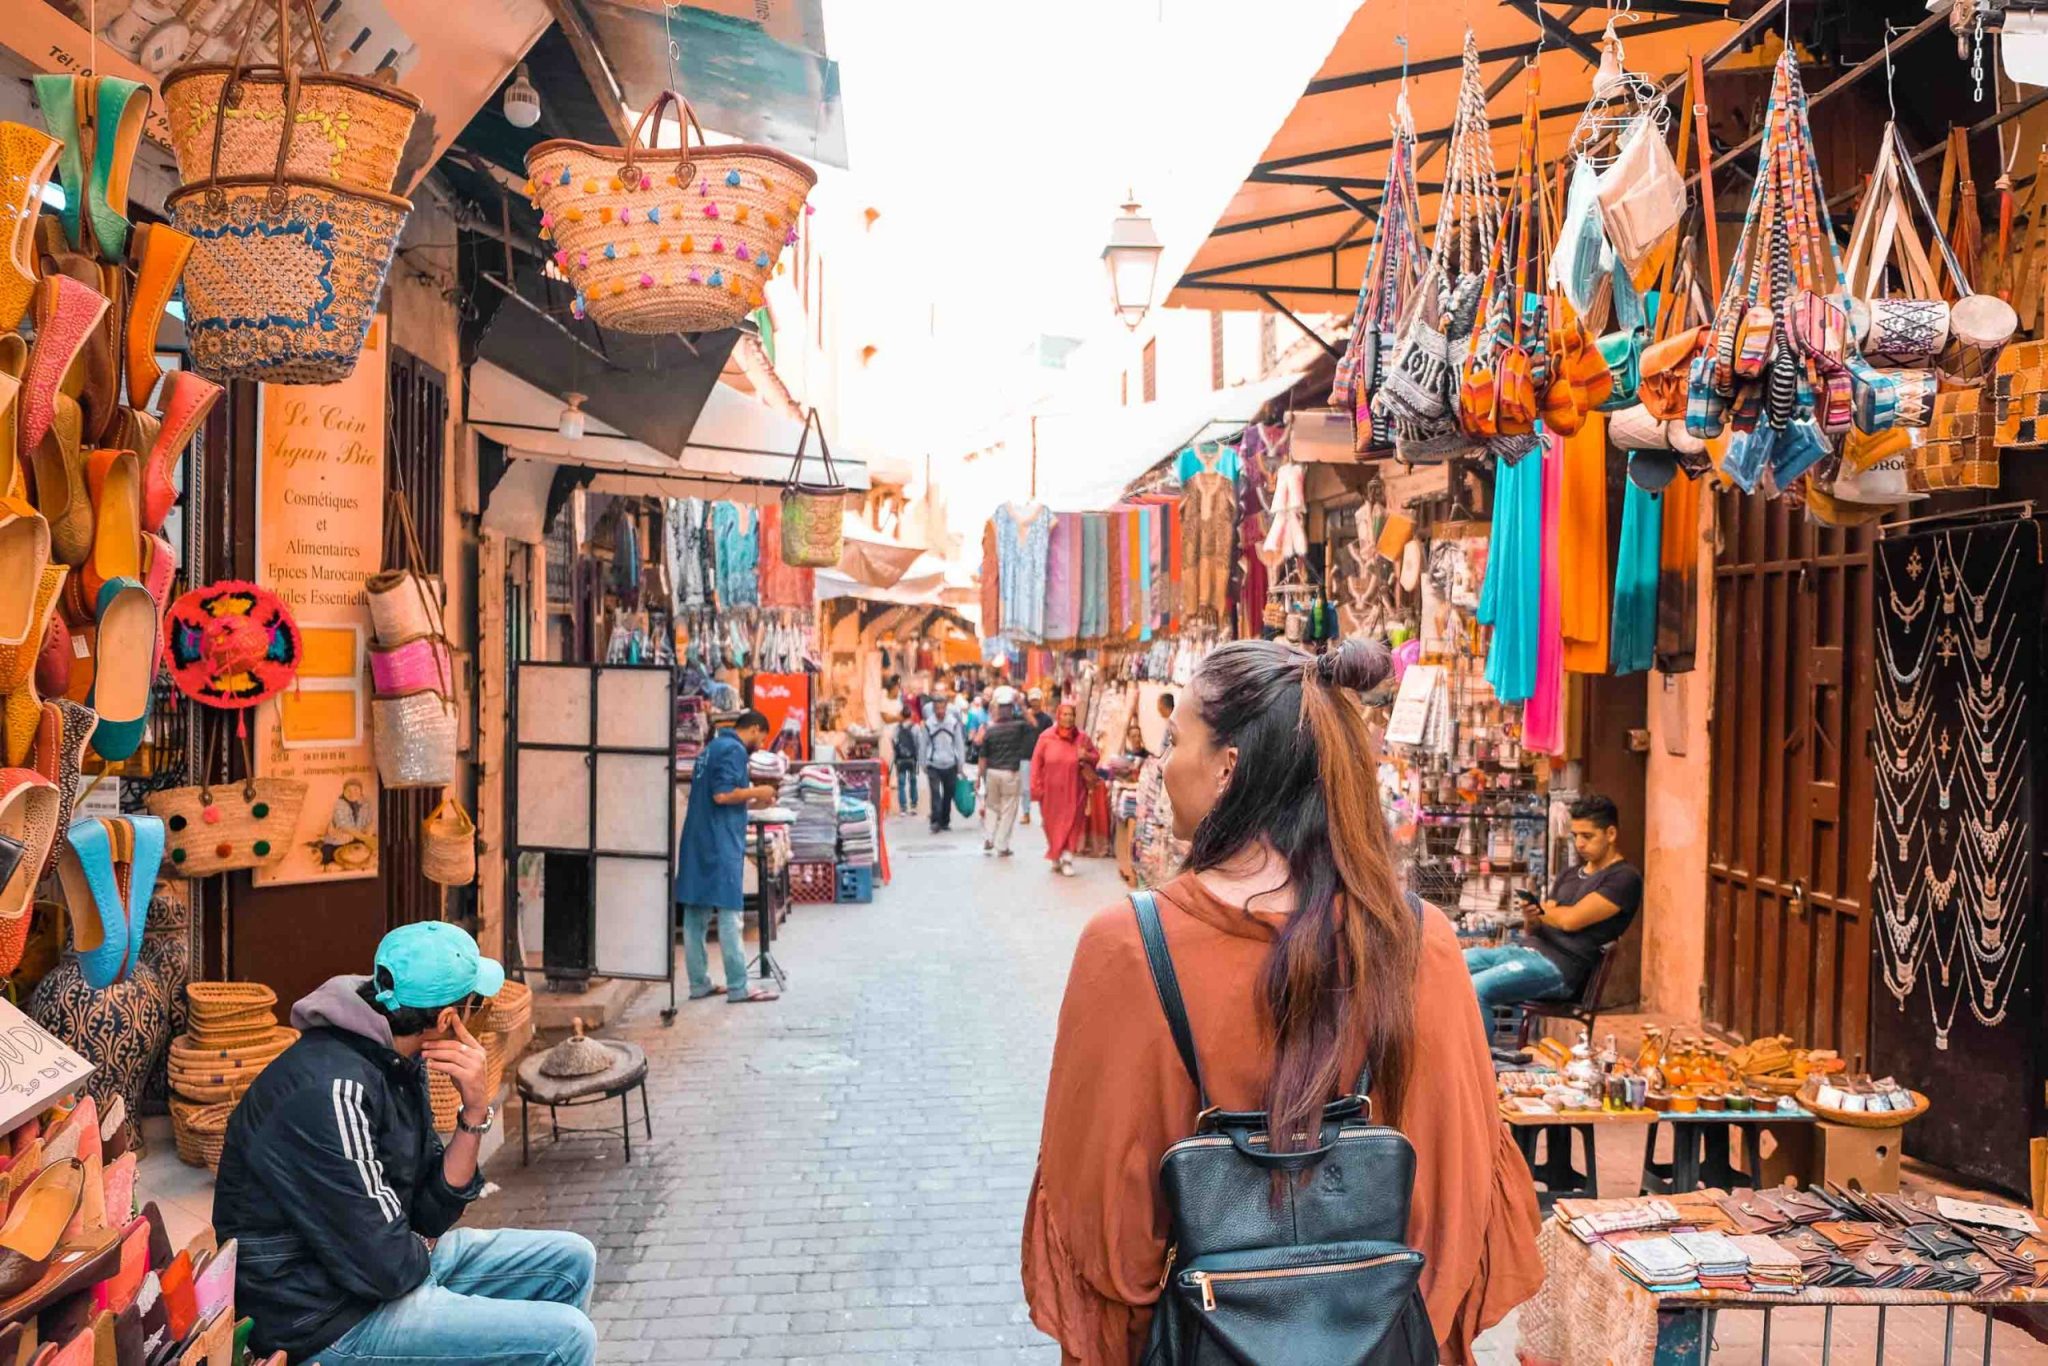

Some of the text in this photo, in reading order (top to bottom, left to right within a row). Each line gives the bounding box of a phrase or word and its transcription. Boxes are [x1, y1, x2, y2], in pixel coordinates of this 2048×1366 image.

[48, 45, 75, 67] Tél
[284, 400, 366, 433] Le Coin
[336, 441, 376, 465] Bio
[284, 488, 359, 512] Cosmétiques
[316, 519, 327, 531] et
[285, 539, 361, 557] Alimentaires
[268, 562, 370, 582] Epices Marocaine
[269, 587, 370, 606] uiles Essentielle
